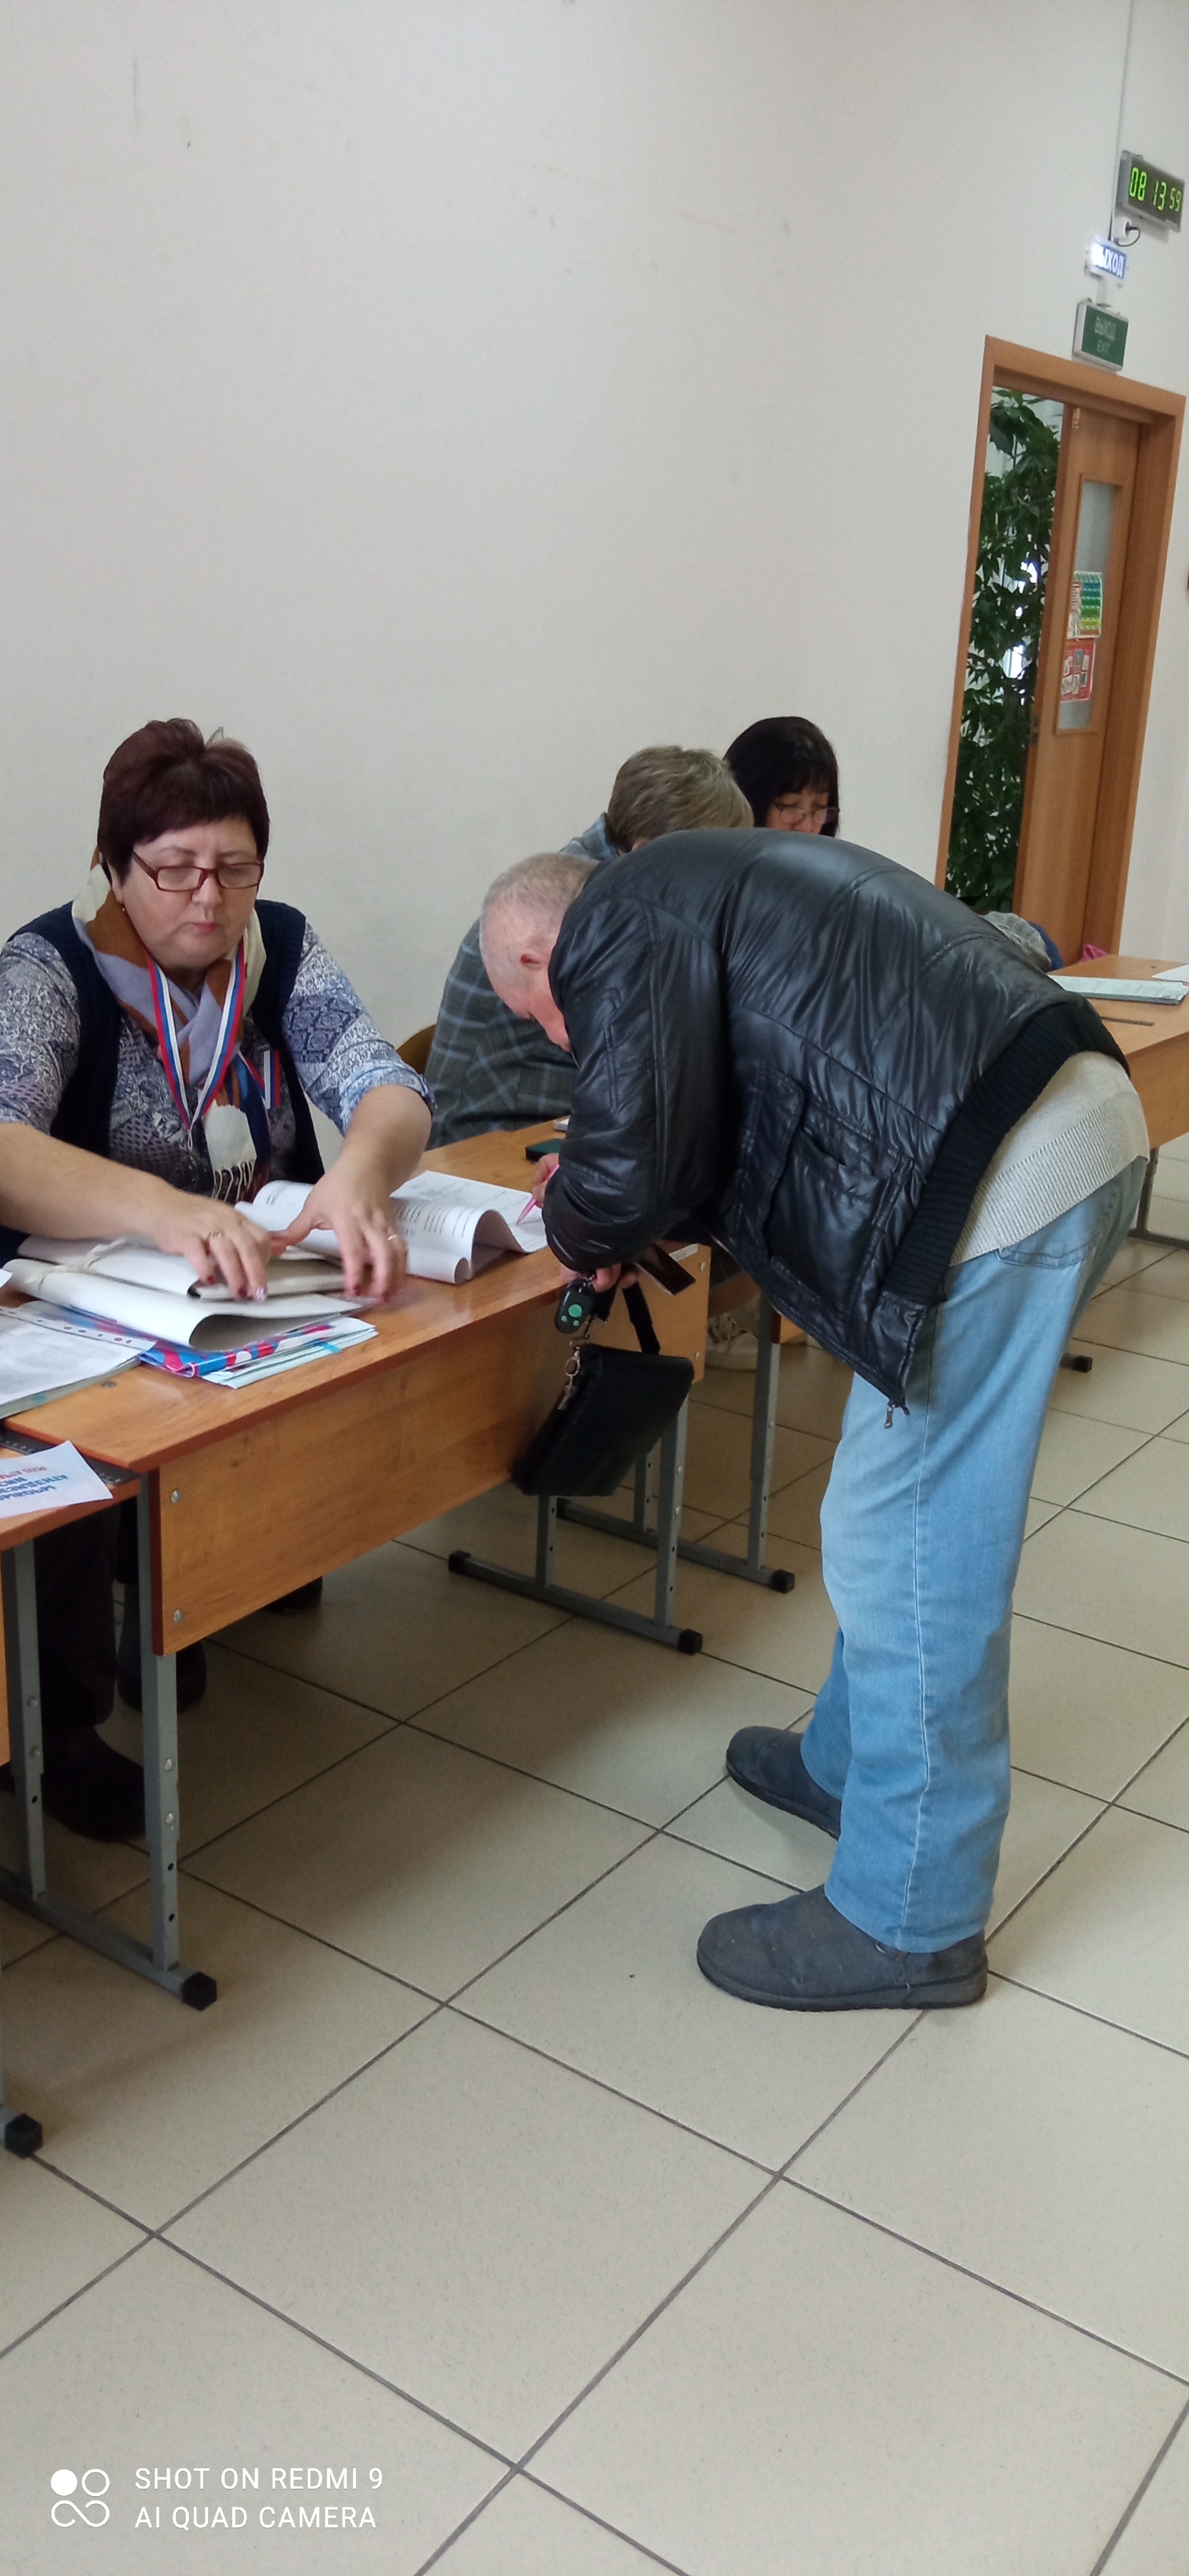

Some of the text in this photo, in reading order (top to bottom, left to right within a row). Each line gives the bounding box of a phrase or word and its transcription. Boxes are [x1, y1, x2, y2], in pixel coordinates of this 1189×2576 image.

[1130, 167, 1181, 212] 08 13 59
